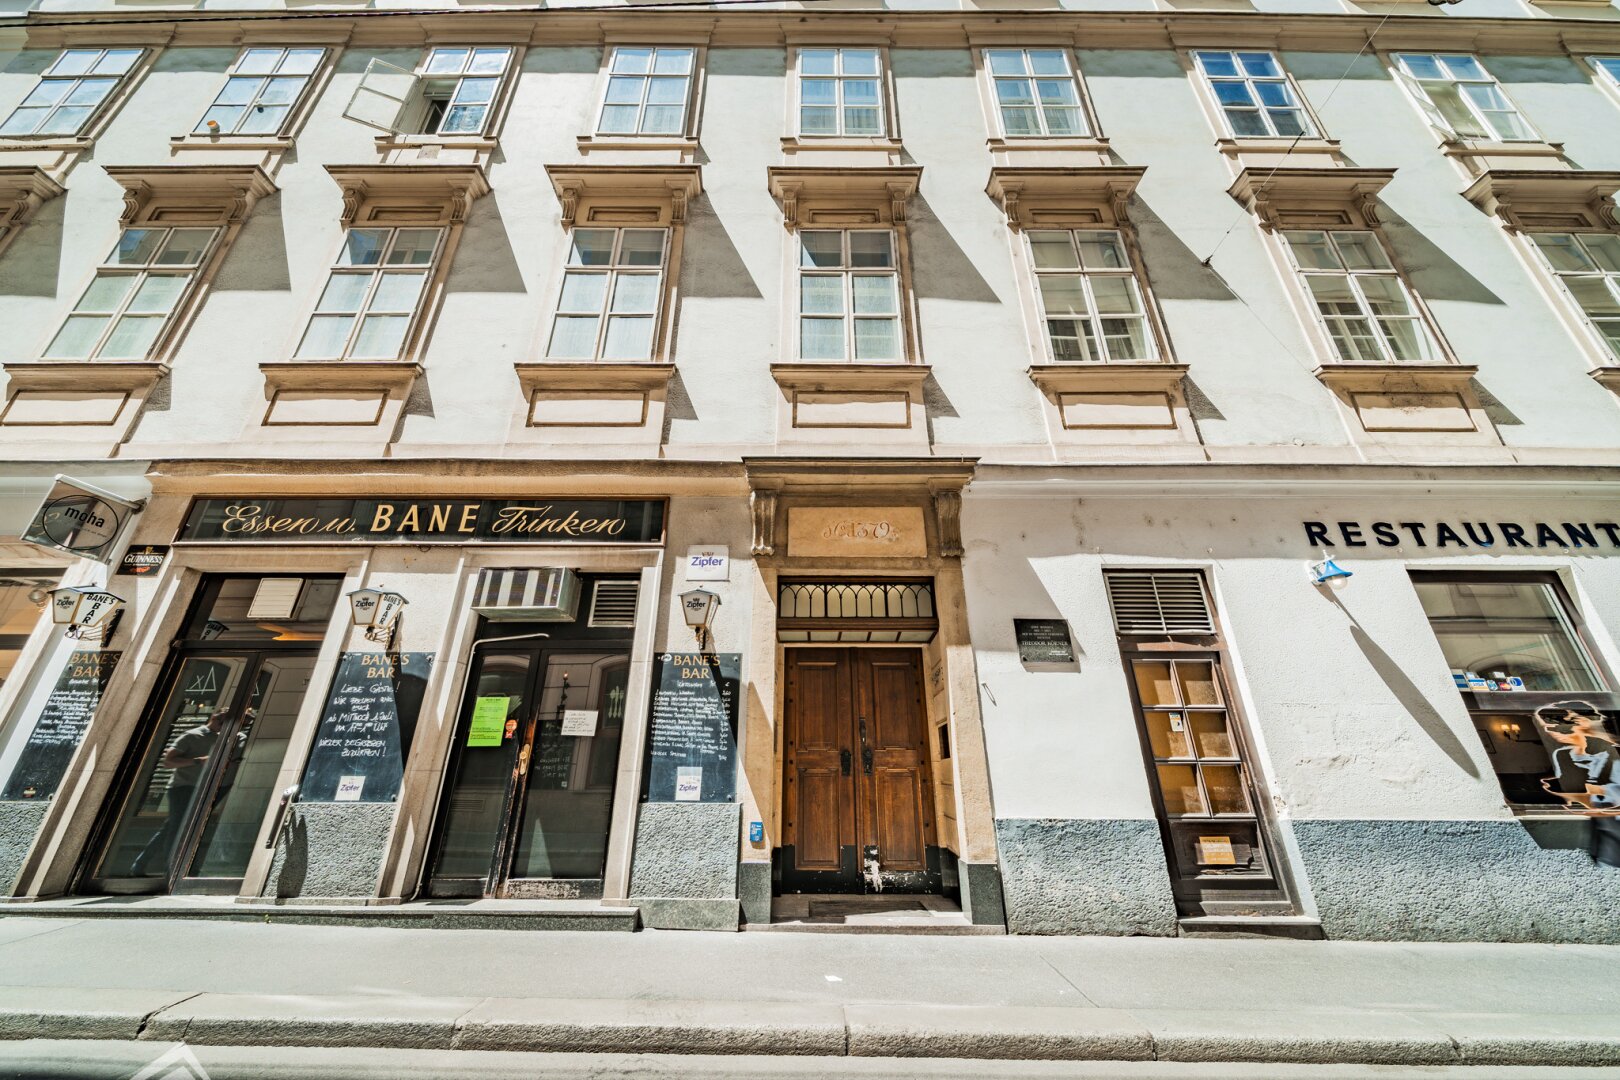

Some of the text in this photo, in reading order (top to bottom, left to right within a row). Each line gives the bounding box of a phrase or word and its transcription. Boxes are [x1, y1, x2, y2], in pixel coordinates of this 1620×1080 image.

[64, 506, 105, 528] moha
[222, 505, 320, 534] Essen
[370, 504, 480, 532] BANE
[491, 505, 626, 536] Trinken
[1302, 521, 1620, 548] RESTAURANT
[124, 553, 164, 565] GUINNESS
[691, 556, 723, 568] Zipfer
[56, 599, 76, 607] Zipfer
[86, 593, 117, 605] BANE'S
[355, 600, 375, 608] Zipfer
[686, 600, 706, 608] Zipfer
[81, 602, 101, 624] BAR
[70, 653, 121, 664] BANE'S
[361, 654, 410, 666] BANE'S
[673, 655, 721, 666] BANE'S
[73, 666, 103, 677] BAR
[367, 667, 395, 678] BAR
[682, 668, 710, 679] BAR
[340, 784, 360, 792] Zipfer
[679, 784, 698, 792] Zipfer
